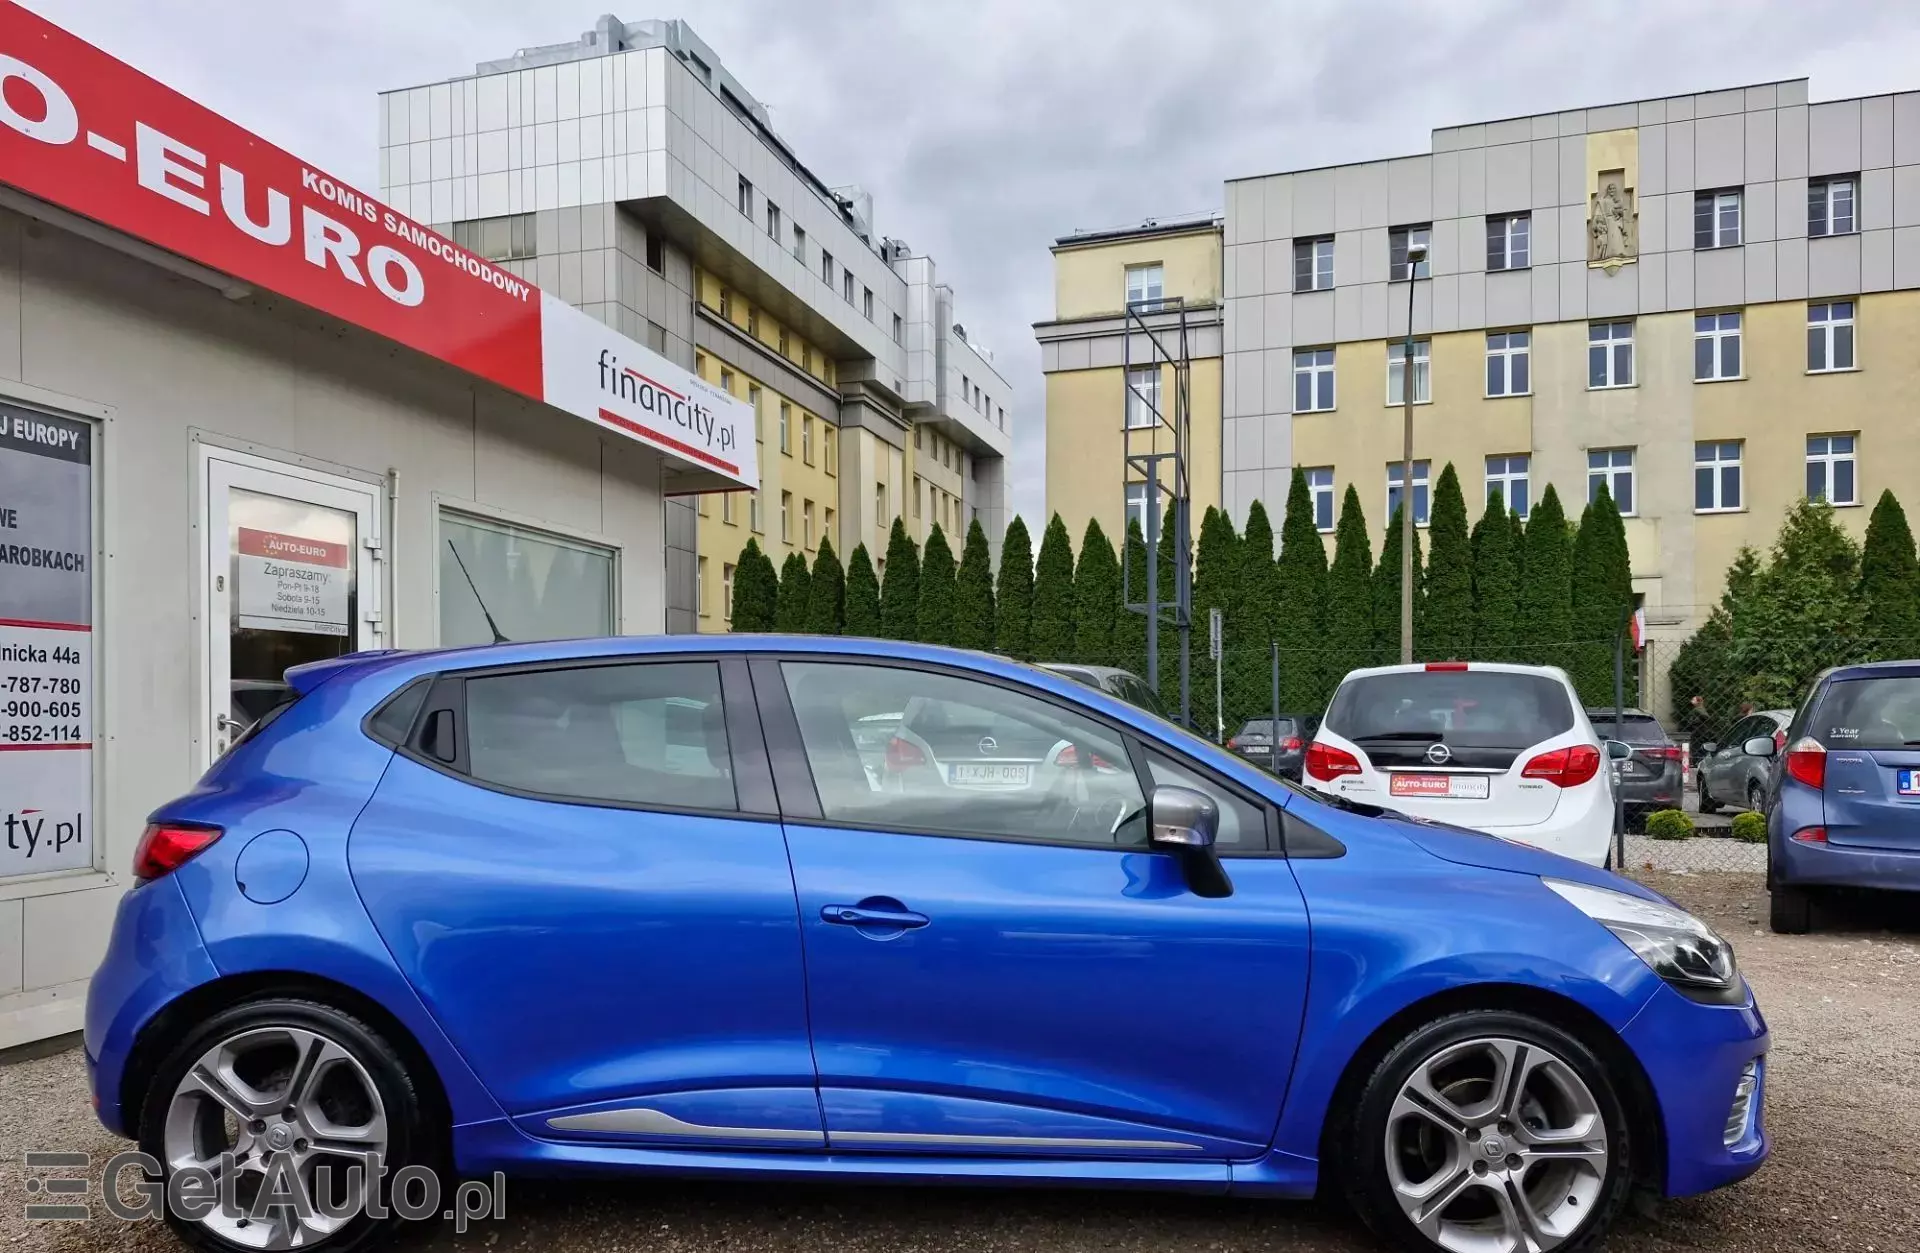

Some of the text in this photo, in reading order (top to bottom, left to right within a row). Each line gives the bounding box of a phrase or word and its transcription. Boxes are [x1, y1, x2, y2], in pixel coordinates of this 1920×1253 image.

[302, 168, 530, 302] KOMIS SAMOCHODOWY
[598, 349, 736, 452] financity.pl
[14, 418, 79, 450] EUROPY
[269, 540, 327, 557] AUTO-EURO
[271, 603, 326, 616] Niedziela 10-15
[53, 646, 80, 664] 44a
[1, 676, 80, 694] -787-780
[1, 701, 81, 718] -900-605
[0, 725, 81, 742] -852-114
[1831, 727, 1860, 735] 5 Year
[1396, 780, 1447, 788] AUTO-EURO
